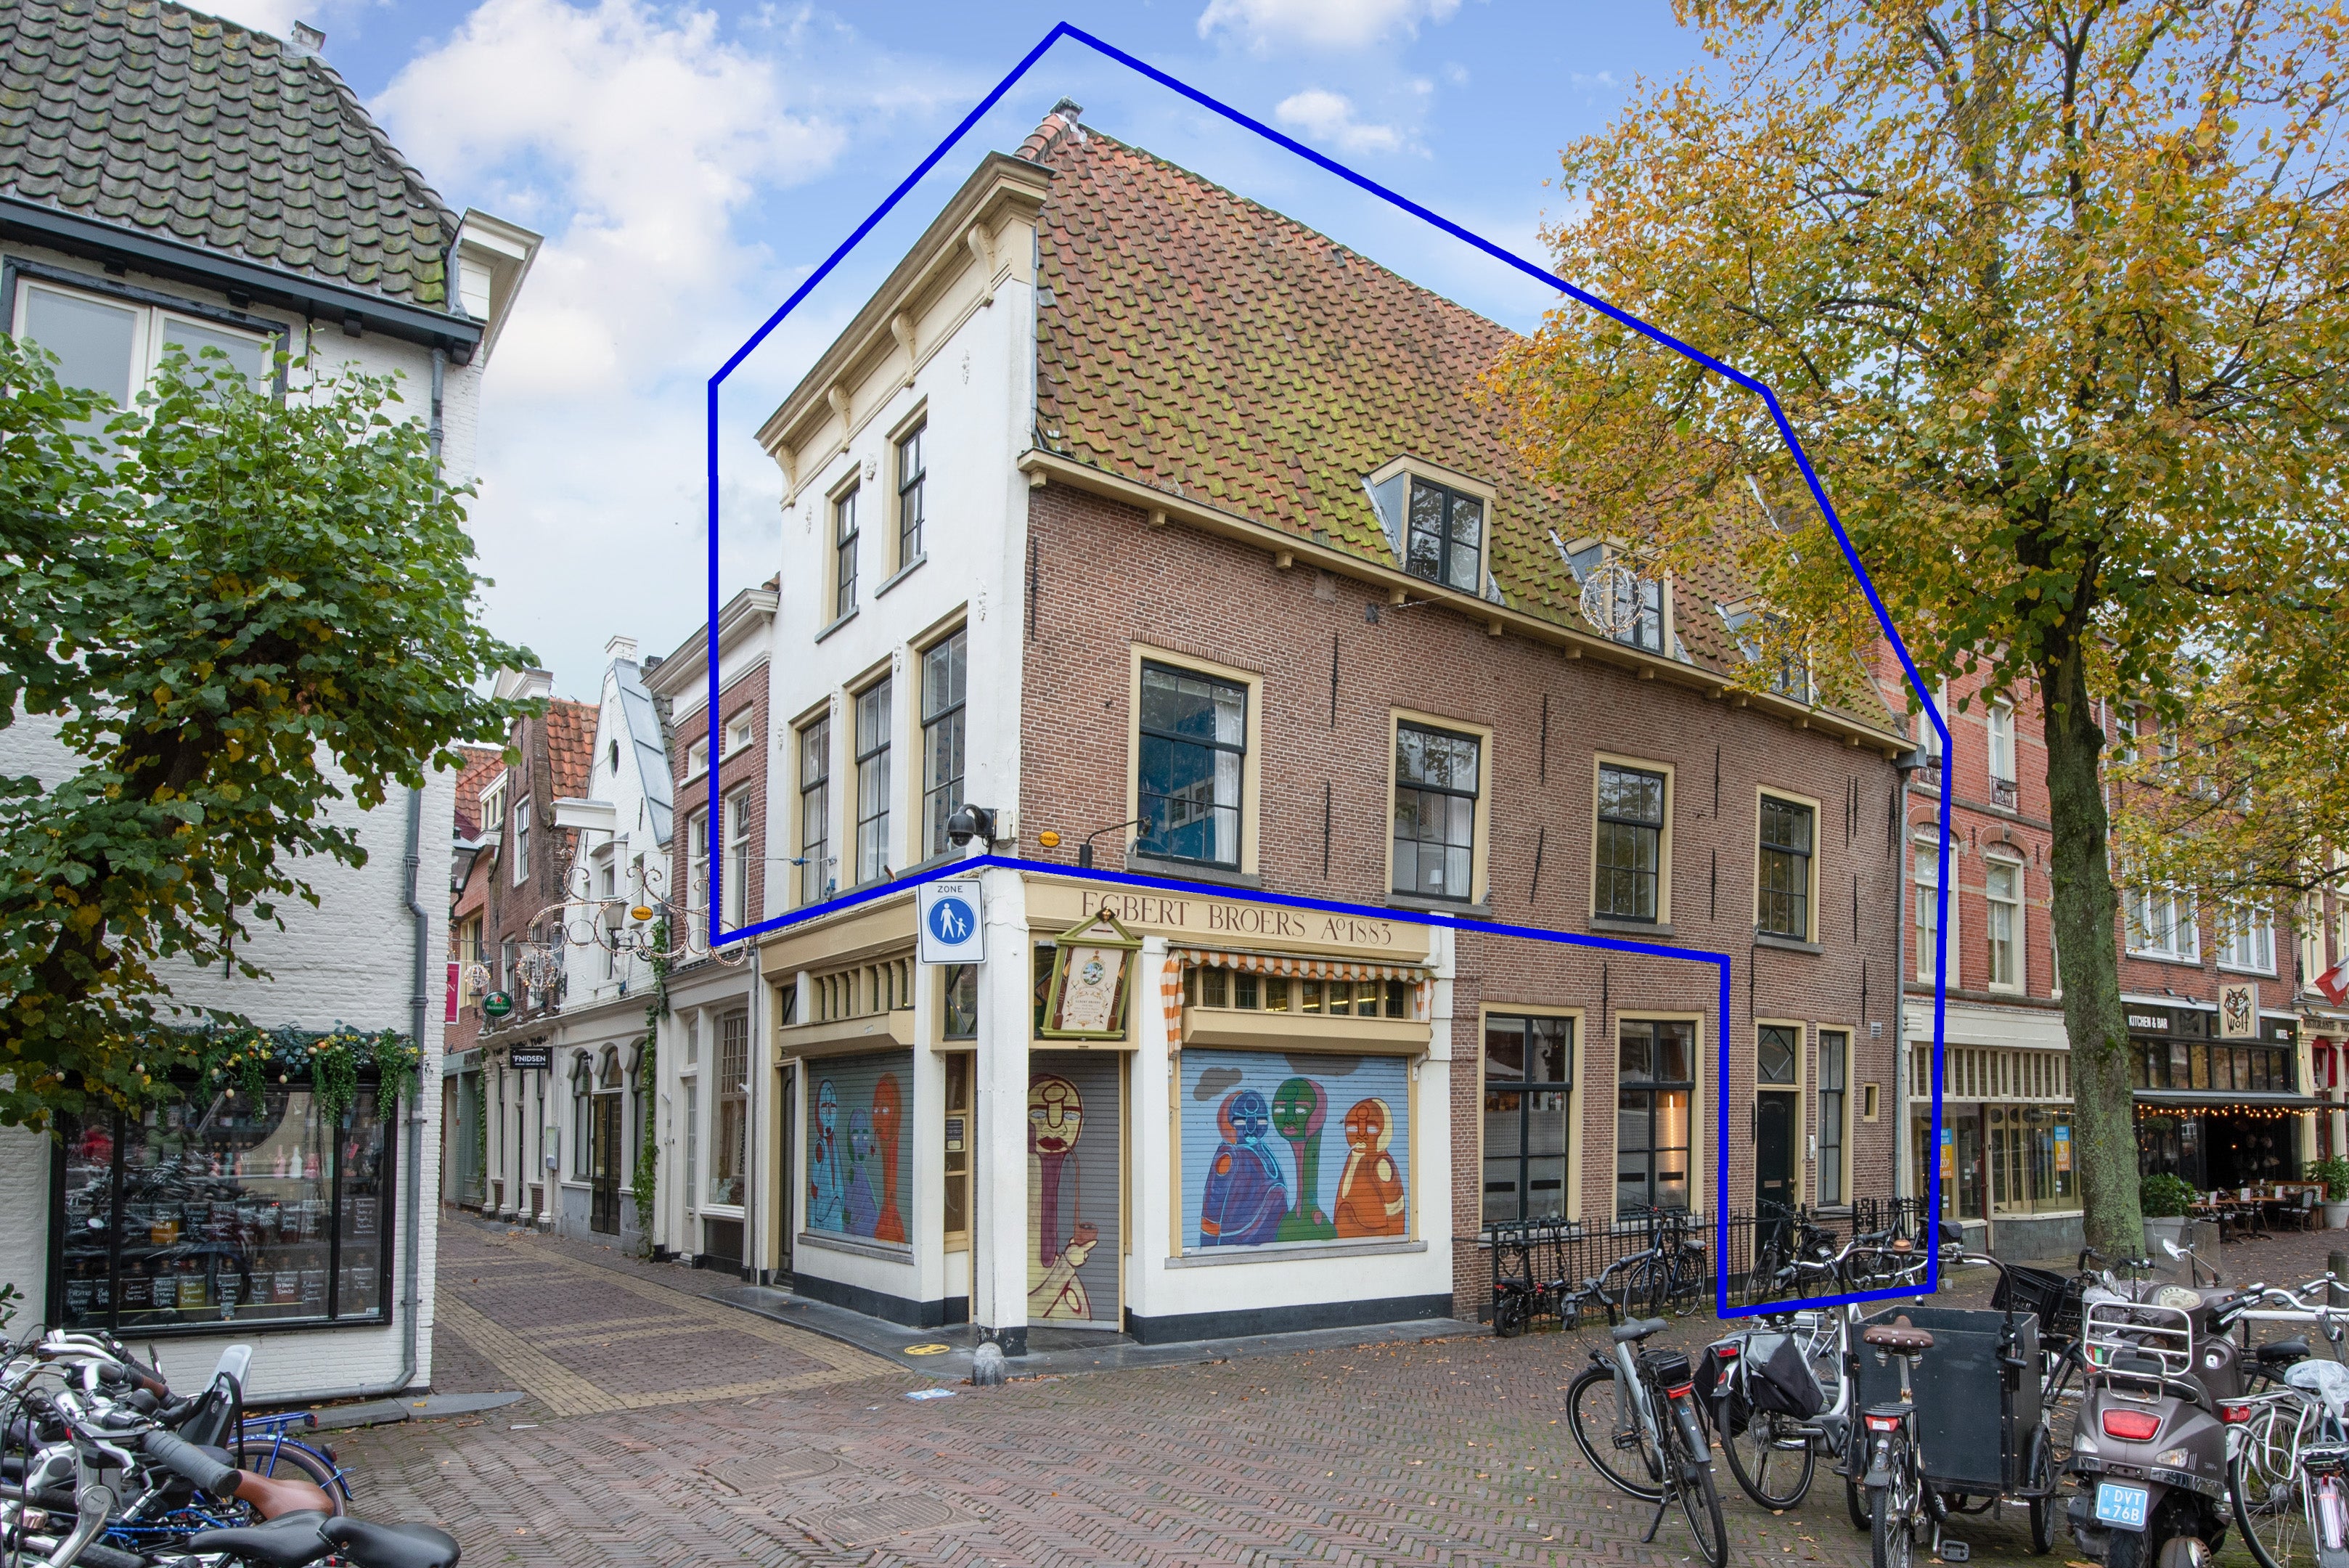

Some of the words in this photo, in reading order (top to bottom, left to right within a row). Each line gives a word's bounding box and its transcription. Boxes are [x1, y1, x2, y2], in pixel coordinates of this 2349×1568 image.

[1081, 891, 1189, 926] EGBERT
[1207, 905, 1305, 936] BROERS
[2128, 1015, 2151, 1028] KITCHEN
[2152, 1017, 2156, 1028] &
[2157, 1018, 2168, 1029] BAR
[2276, 1029, 2289, 1040] HOTEL
[2114, 1490, 2142, 1506] DVT
[2112, 1504, 2140, 1522] 76B
